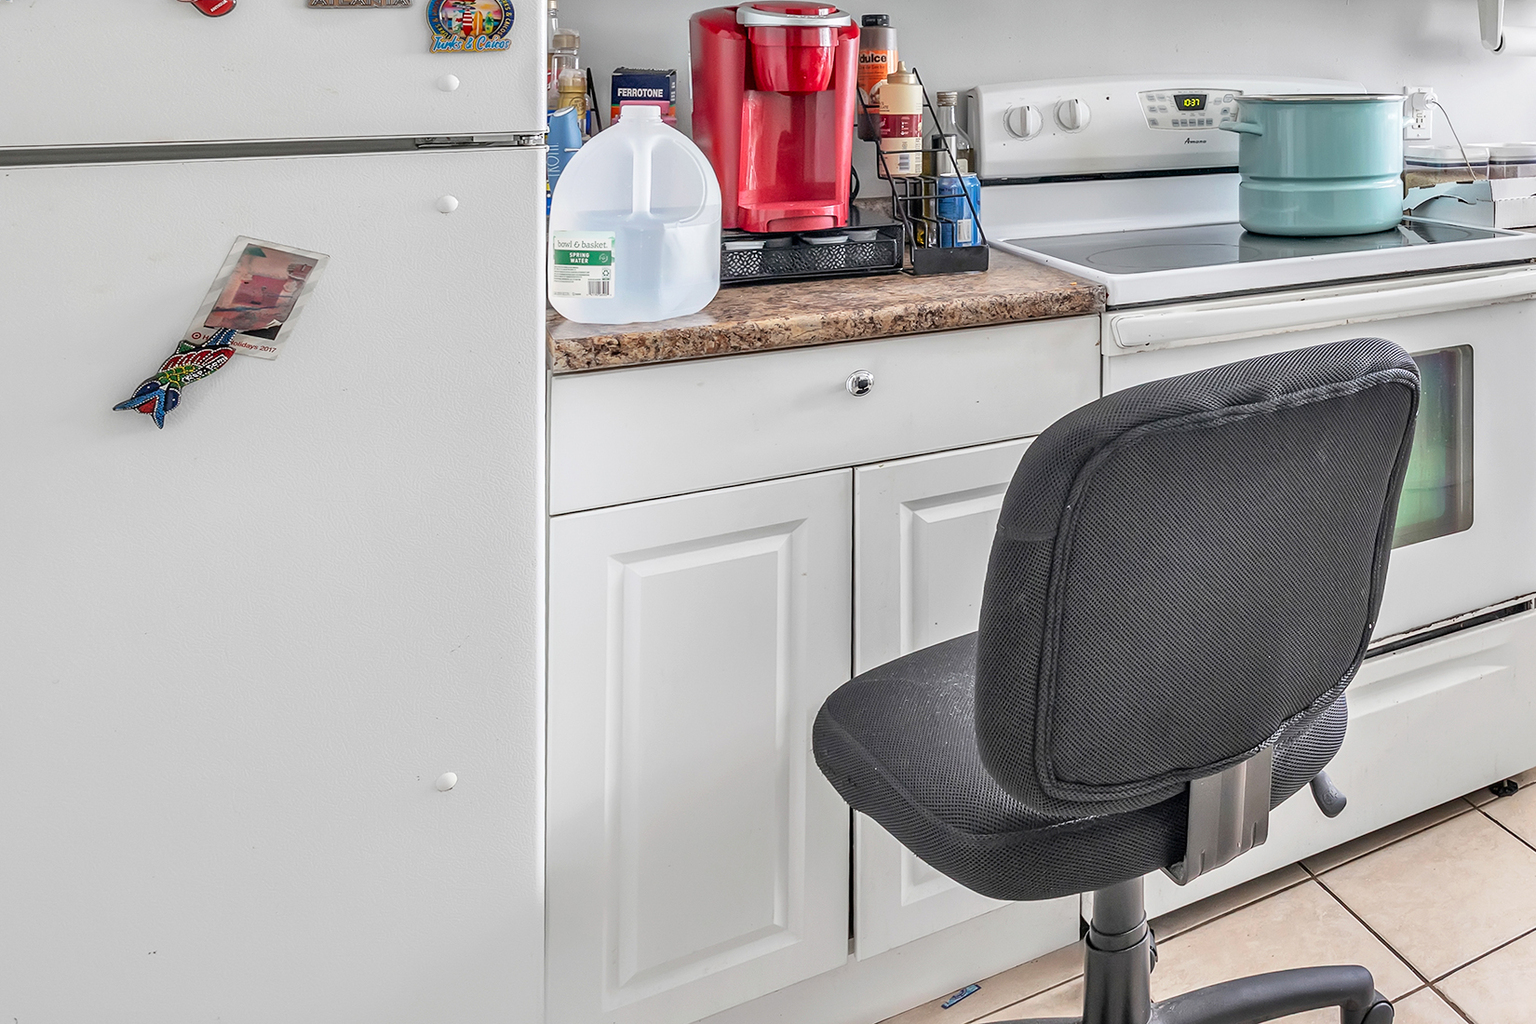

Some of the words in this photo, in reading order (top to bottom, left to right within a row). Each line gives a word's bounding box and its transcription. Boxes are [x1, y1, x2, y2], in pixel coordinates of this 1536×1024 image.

[433, 36, 463, 51] Turks
[465, 36, 474, 49] &
[476, 36, 511, 51] Caicos
[859, 53, 887, 64] dulce
[618, 88, 664, 98] FERROTONE
[557, 240, 572, 248] bowl
[259, 344, 277, 354] 2017
